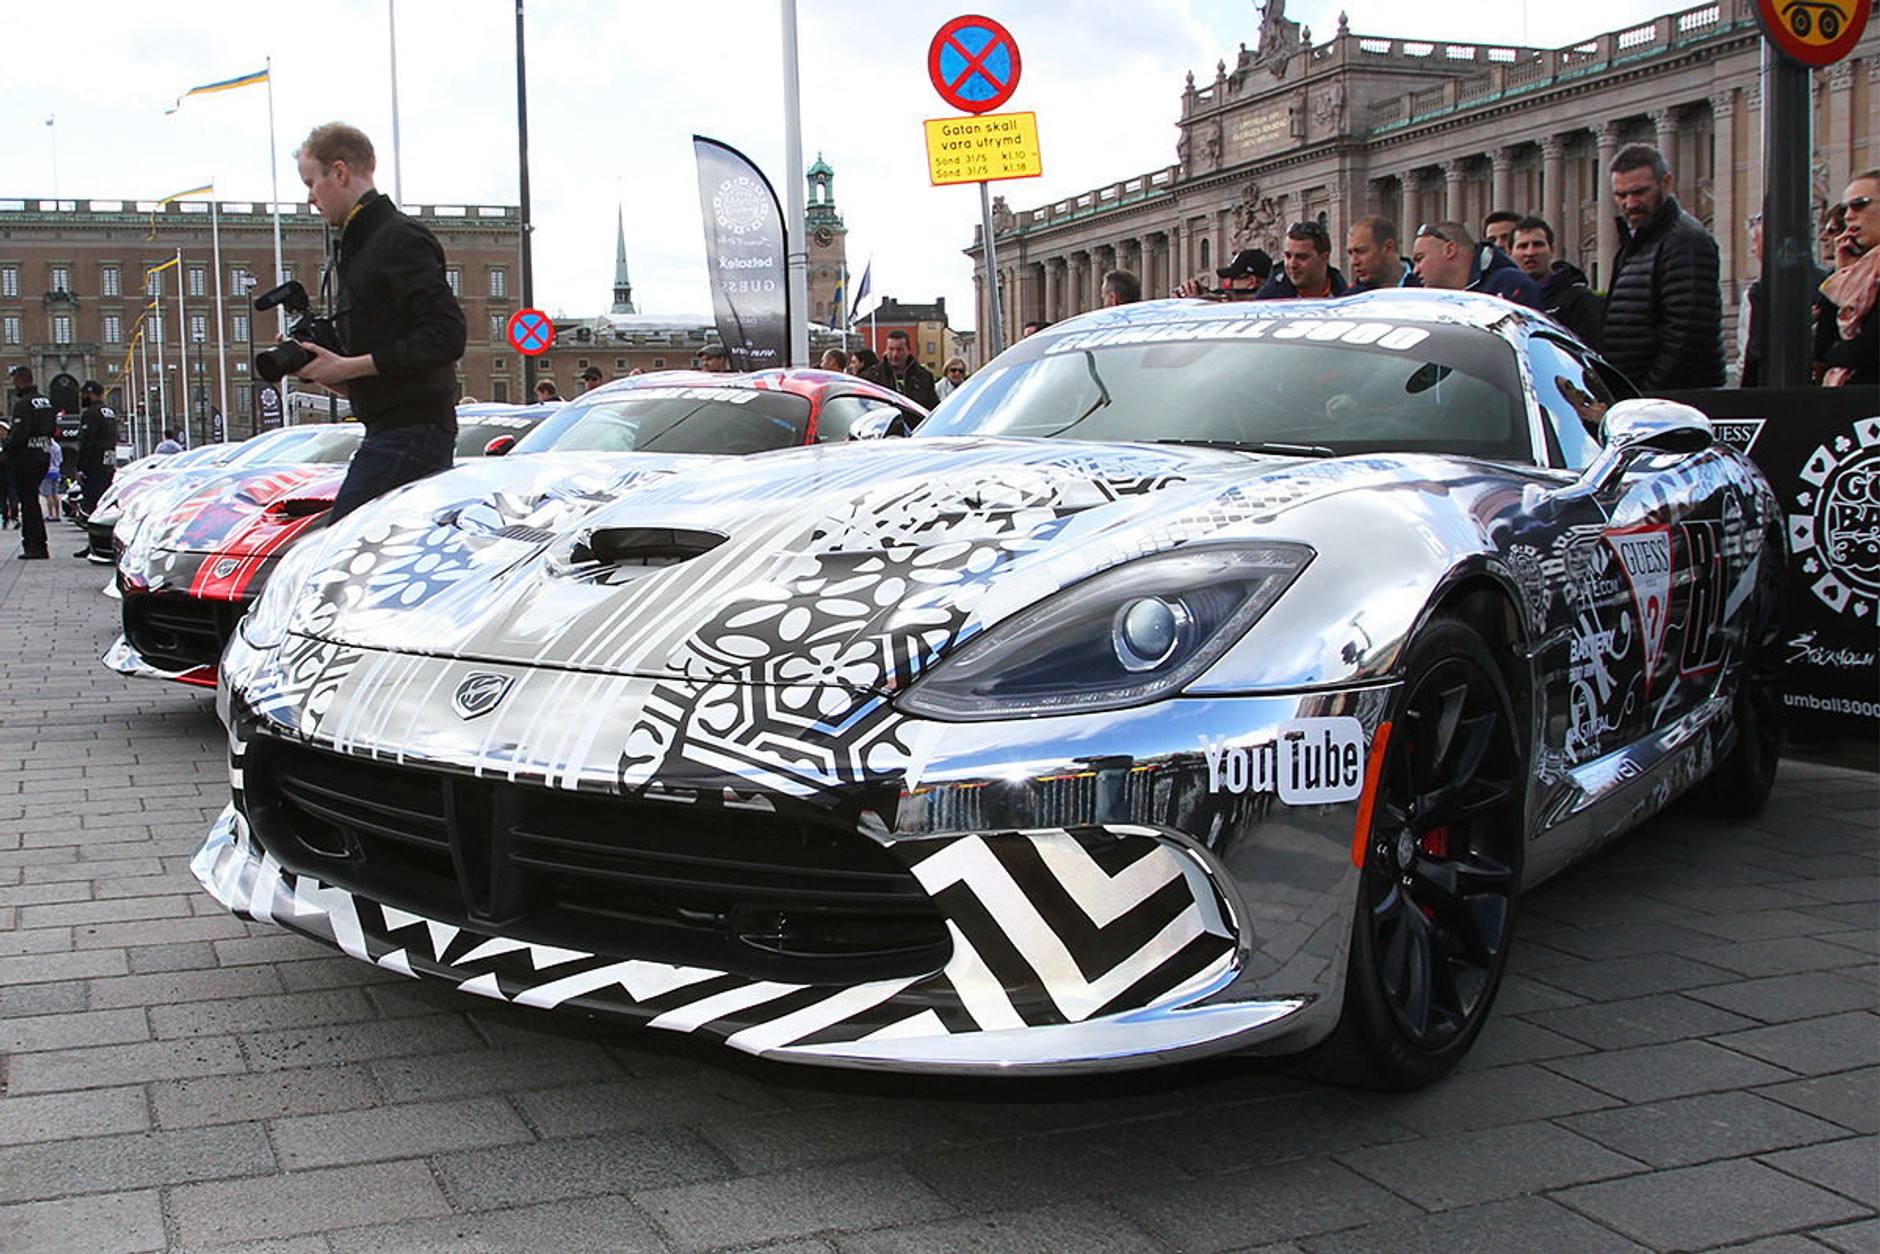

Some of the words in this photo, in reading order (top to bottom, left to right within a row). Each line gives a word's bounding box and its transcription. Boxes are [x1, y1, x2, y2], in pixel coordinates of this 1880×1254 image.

[942, 124, 981, 136] Gatan
[986, 120, 1018, 132] skall
[941, 139, 971, 150] vara
[976, 134, 1022, 148] utrymd
[966, 154, 987, 163] 31/5
[1272, 320, 1430, 350] 3000
[1712, 425, 1751, 442] UESS
[1620, 539, 1670, 576] GUESS
[1783, 694, 1880, 718] umball3000
[1198, 730, 1358, 794] YouTube
